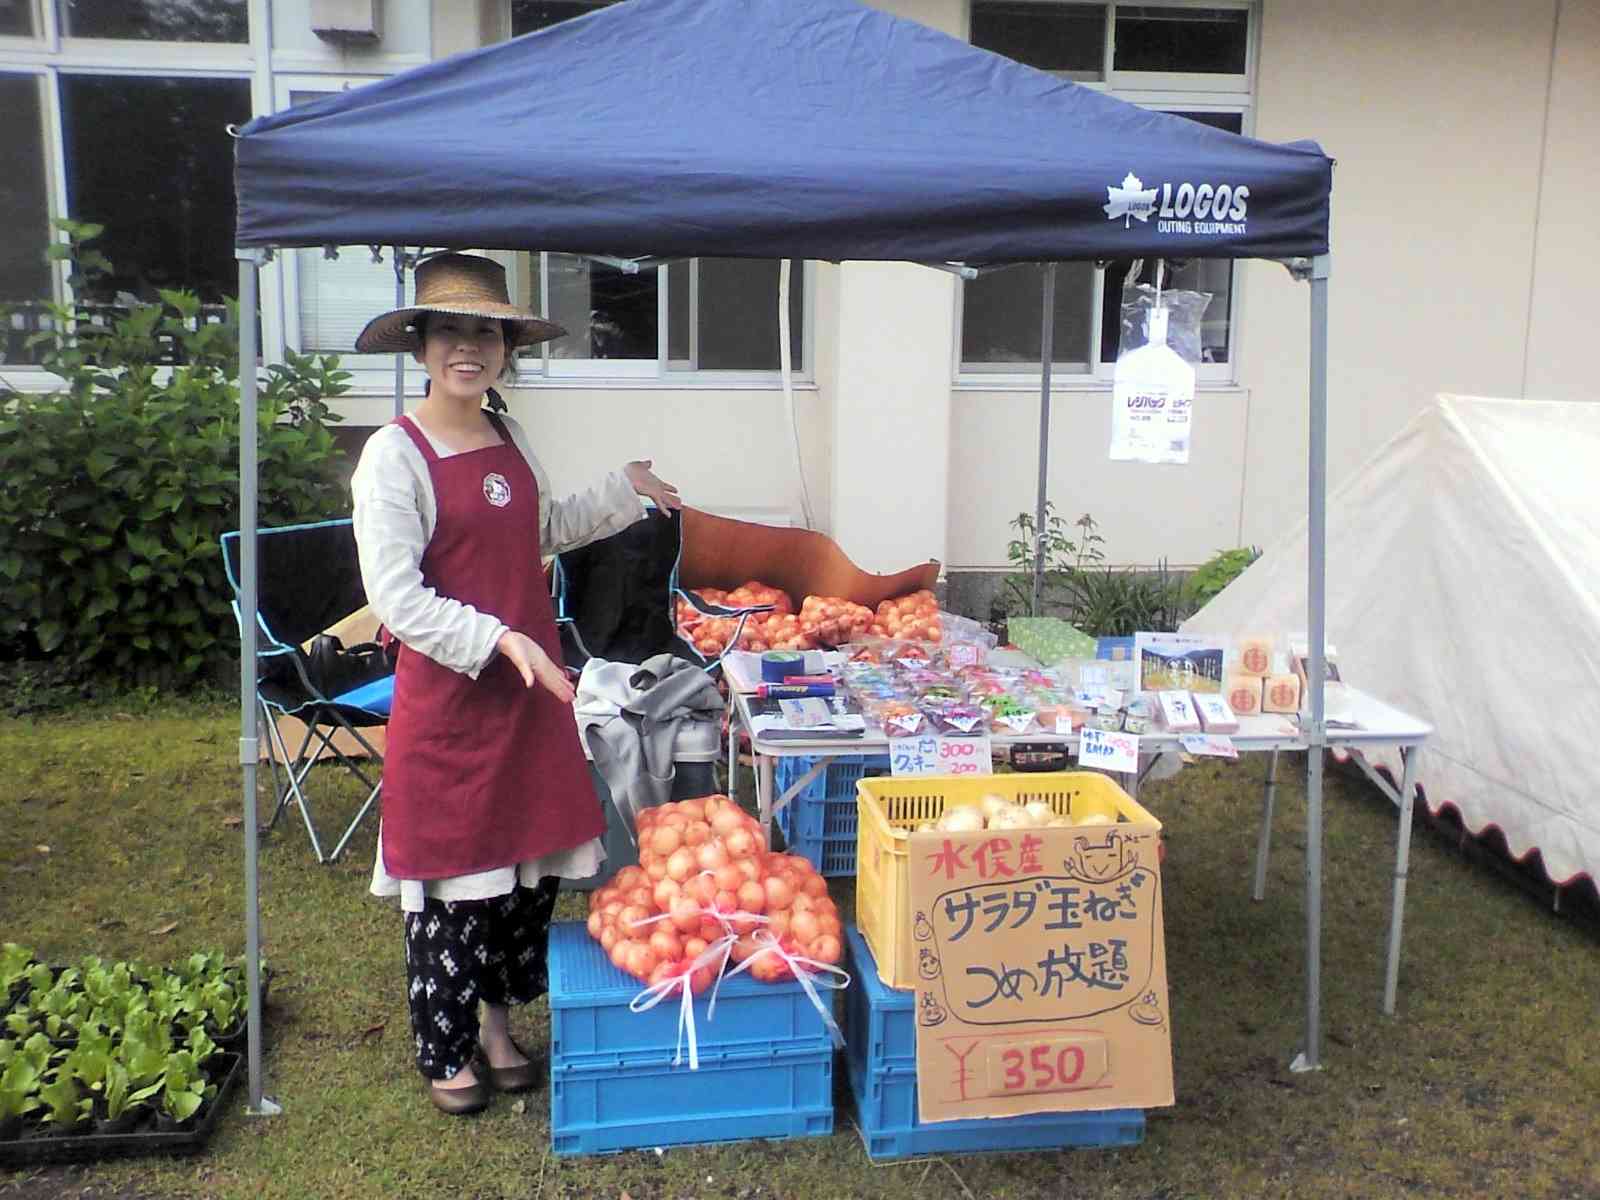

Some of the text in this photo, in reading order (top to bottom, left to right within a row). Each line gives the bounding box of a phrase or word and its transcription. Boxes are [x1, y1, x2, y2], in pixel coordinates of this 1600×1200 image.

[1159, 183, 1249, 221] LOGOS
[1157, 220, 1246, 235] OUTING EQUIPMENT
[940, 742, 974, 758] 300
[951, 762, 977, 774] 200
[926, 833, 1046, 881] 水俣産
[945, 872, 1147, 942] サラダ玉ねぎ
[966, 938, 1131, 1009] つめ放題
